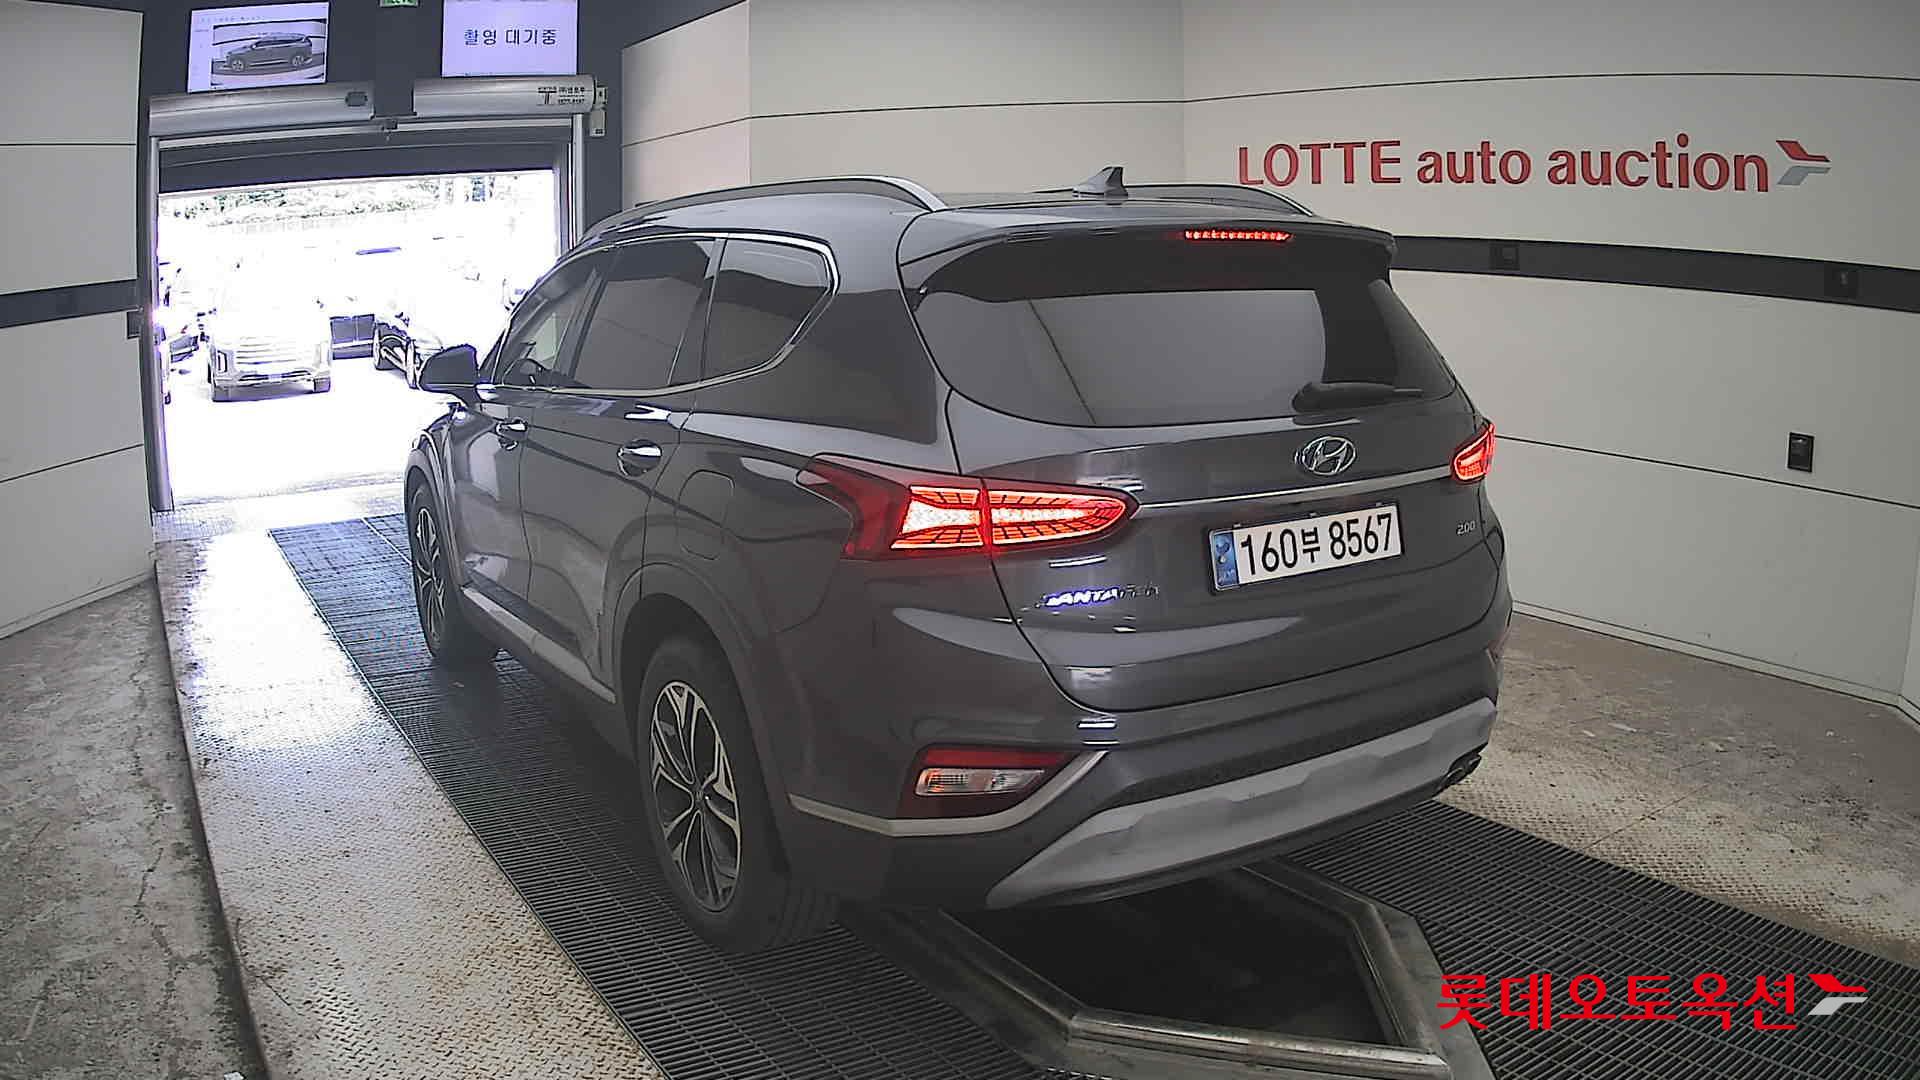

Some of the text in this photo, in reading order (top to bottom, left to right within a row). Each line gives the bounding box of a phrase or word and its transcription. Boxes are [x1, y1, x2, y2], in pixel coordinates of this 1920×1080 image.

[464, 29, 557, 46] 촬영 대기중
[1238, 134, 1769, 192] LOTTE auto auction
[1240, 526, 1321, 576] 160부
[1328, 512, 1393, 561] 8567
